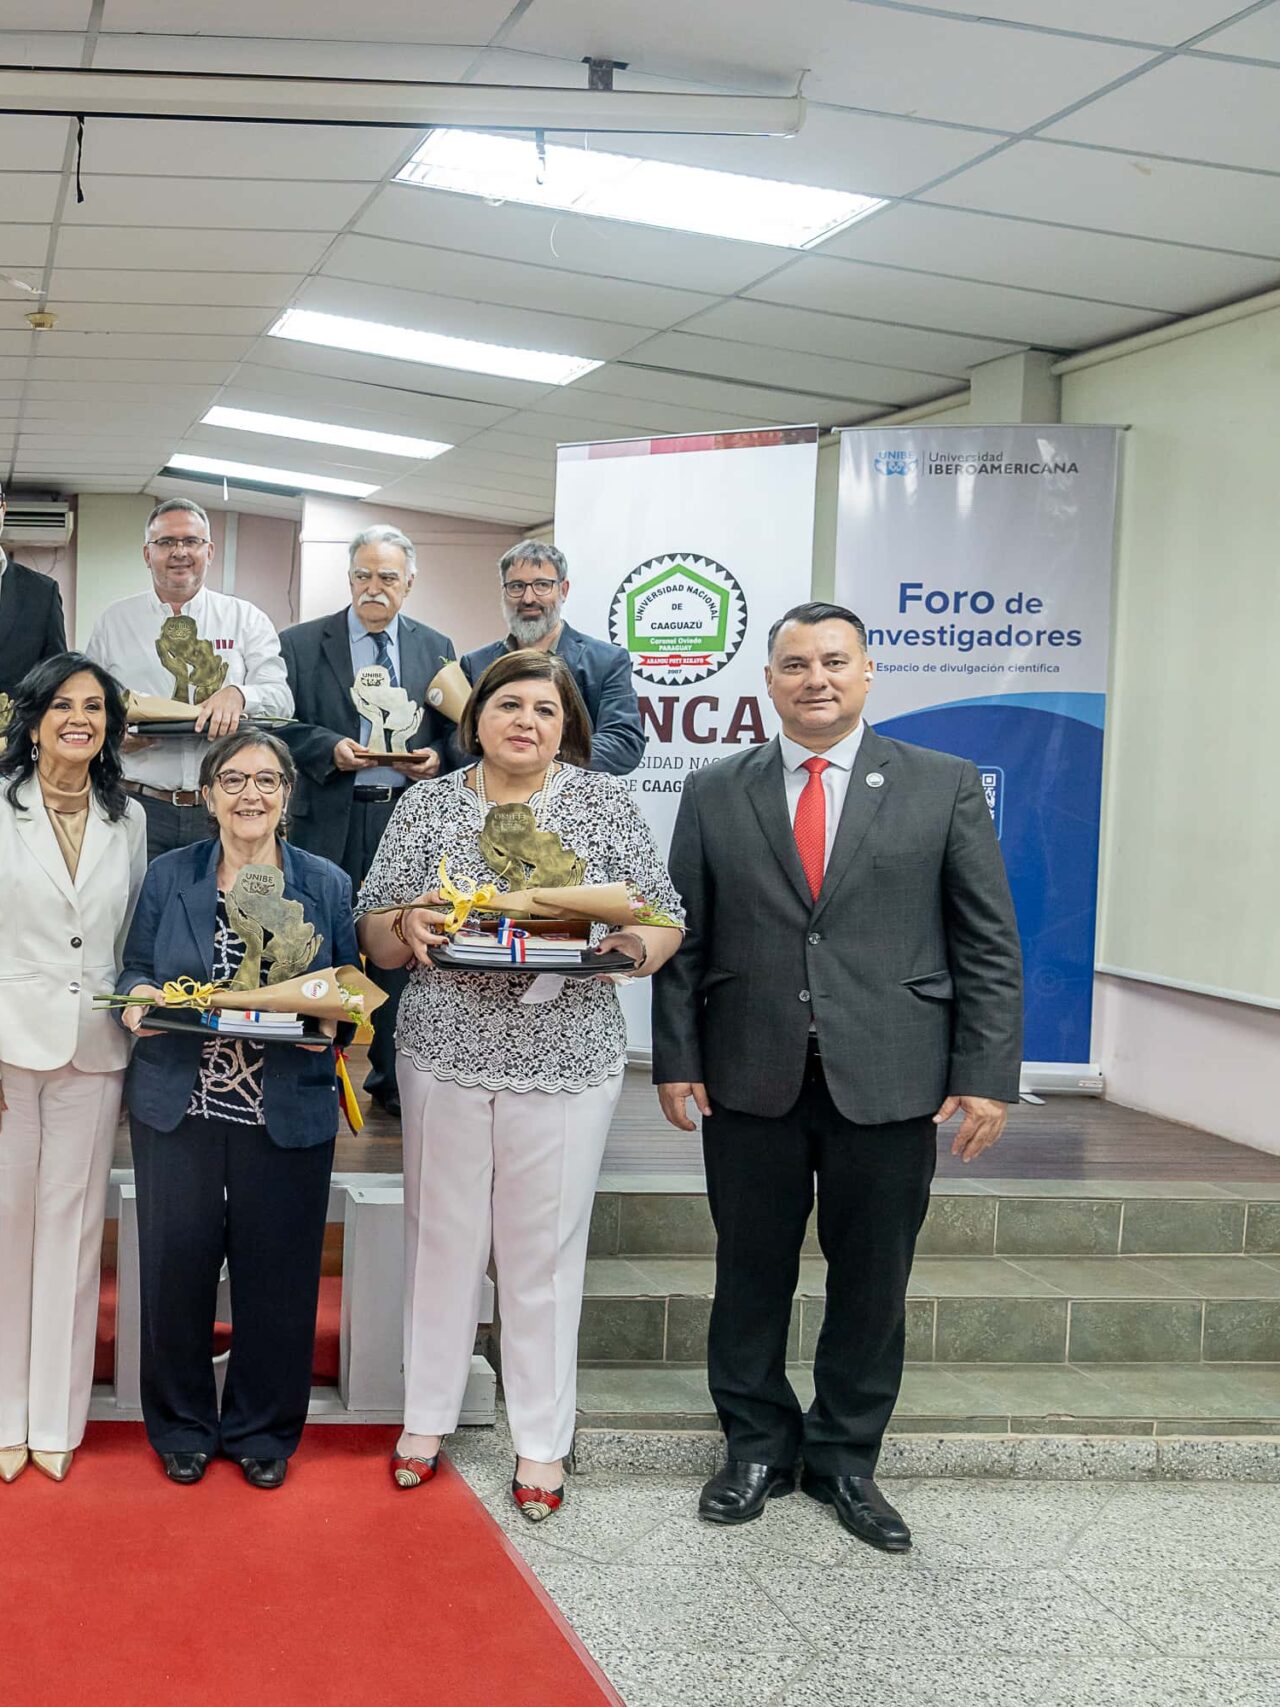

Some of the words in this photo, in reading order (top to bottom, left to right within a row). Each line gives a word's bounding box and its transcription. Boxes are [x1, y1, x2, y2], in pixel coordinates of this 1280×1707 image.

[929, 451, 1003, 462] Universidad
[928, 462, 1079, 475] IBEROAMERICANA
[635, 584, 685, 621] UNIVERSIDAD
[686, 585, 720, 620] NACIONAL
[898, 582, 995, 614] Foro
[1005, 592, 1043, 614] de
[671, 603, 683, 611] DE
[650, 620, 703, 630] CAAGUAZÚ
[866, 624, 1082, 651] nvestigadores
[876, 662, 919, 673] Espacio
[923, 662, 937, 672] de
[940, 662, 1005, 674] divulgación
[1008, 663, 1060, 673] científica
[637, 695, 769, 744] NCA
[638, 756, 684, 769] SIDAD
[642, 780, 682, 792] CAAG
[245, 873, 274, 883] UNIBE
